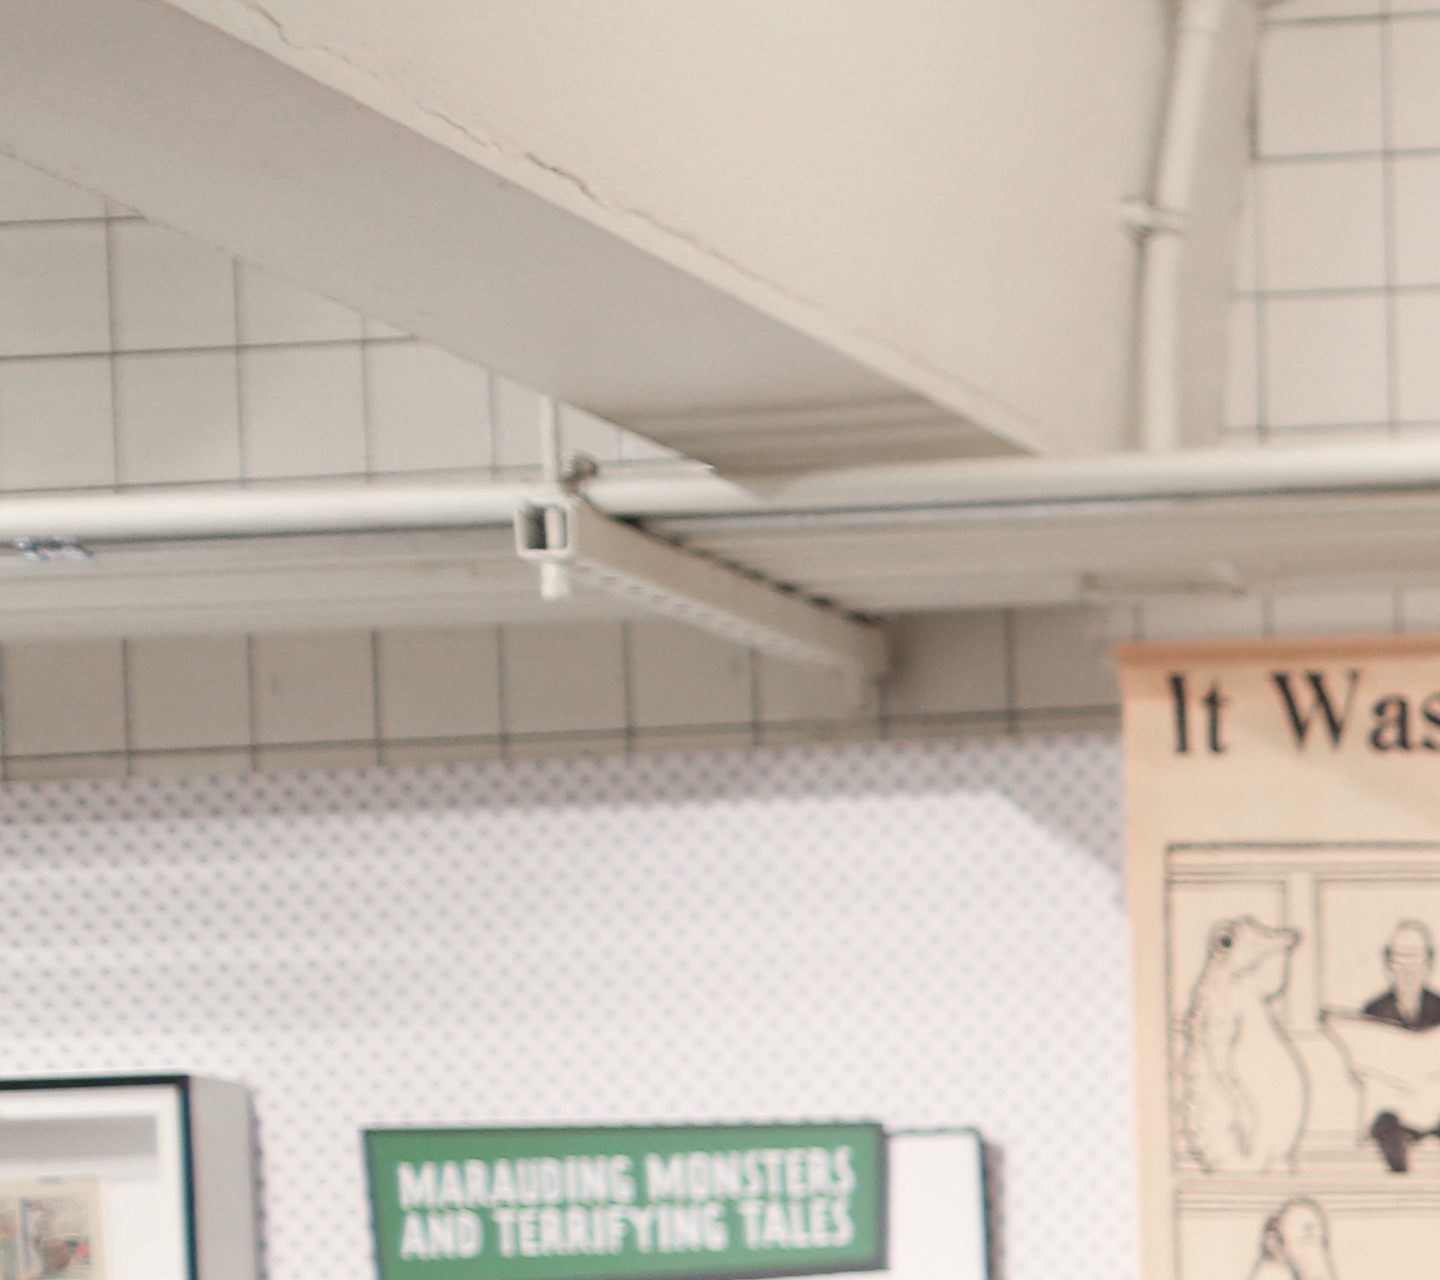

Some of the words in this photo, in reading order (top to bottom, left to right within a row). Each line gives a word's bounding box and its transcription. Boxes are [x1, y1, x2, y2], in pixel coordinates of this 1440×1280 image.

[1168, 670, 1229, 755] It
[397, 1151, 636, 1210] MARAUDING
[646, 1145, 857, 1202] MONSTERS
[400, 1208, 485, 1261] AND
[494, 1202, 728, 1259] TERRIFYING
[738, 1197, 857, 1249] TALES
